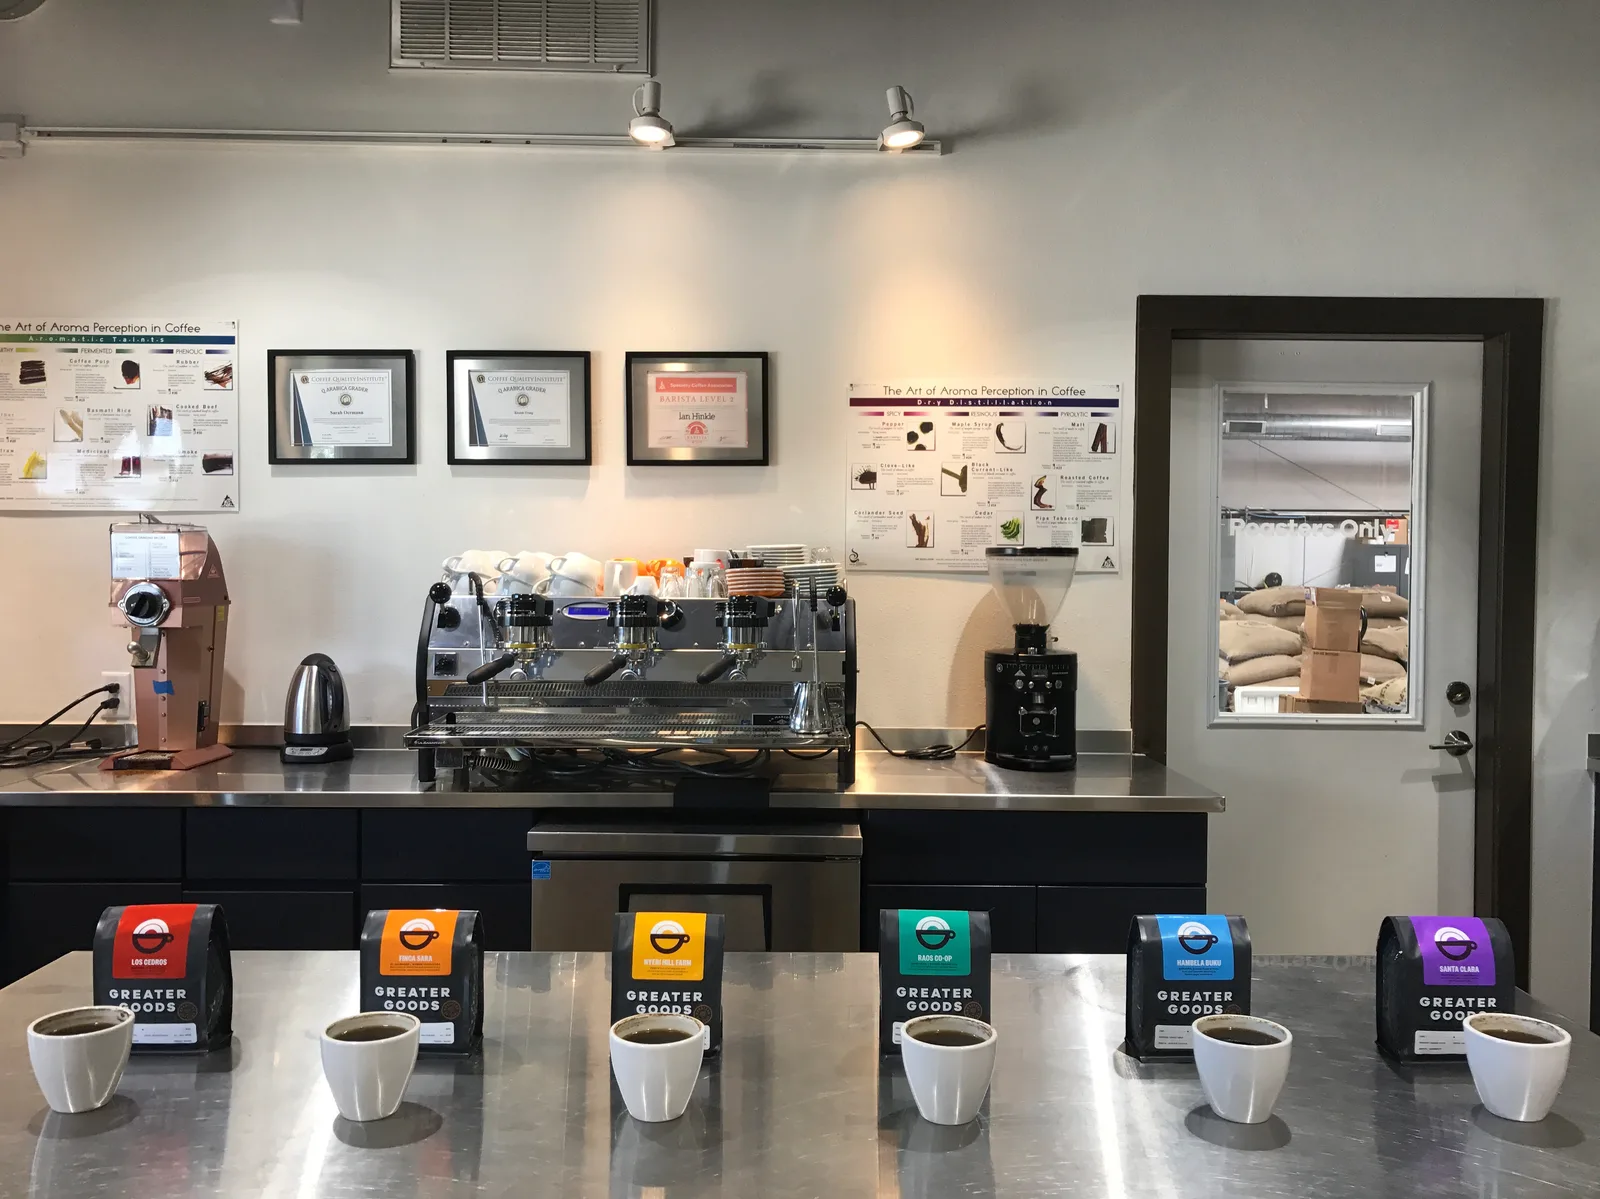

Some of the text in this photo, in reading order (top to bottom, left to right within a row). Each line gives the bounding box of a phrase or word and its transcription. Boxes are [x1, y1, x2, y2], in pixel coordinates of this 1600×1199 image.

[15, 322, 32, 332] Art
[36, 321, 47, 332] of
[50, 322, 90, 333] Aroma
[93, 322, 148, 335] Perception
[151, 323, 161, 333] in
[165, 323, 201, 333] Coffee
[883, 385, 1086, 398] The Art of Aroma Perception in Coffee
[659, 395, 697, 403] BARISTA
[699, 395, 727, 403] LEVEL
[678, 412, 691, 420] Ian
[1229, 518, 1394, 543] Roasters Only
[131, 958, 168, 966] LOS CEDROS
[675, 959, 692, 967] FARM
[917, 954, 953, 962] RAOS CO-OP
[1439, 965, 1480, 973] SANTA CLARA
[109, 988, 187, 999] GREATER
[374, 986, 451, 998] GREATER
[626, 990, 703, 1002] GREATER
[896, 986, 973, 998] GREATER
[1157, 990, 1233, 1002] GREATER
[384, 1000, 440, 1011] GOODS
[906, 1001, 963, 1012] GOODS
[1419, 996, 1497, 1008] GREATER
[636, 1004, 692, 1015] GOODS
[1167, 1004, 1224, 1015] GOODS
